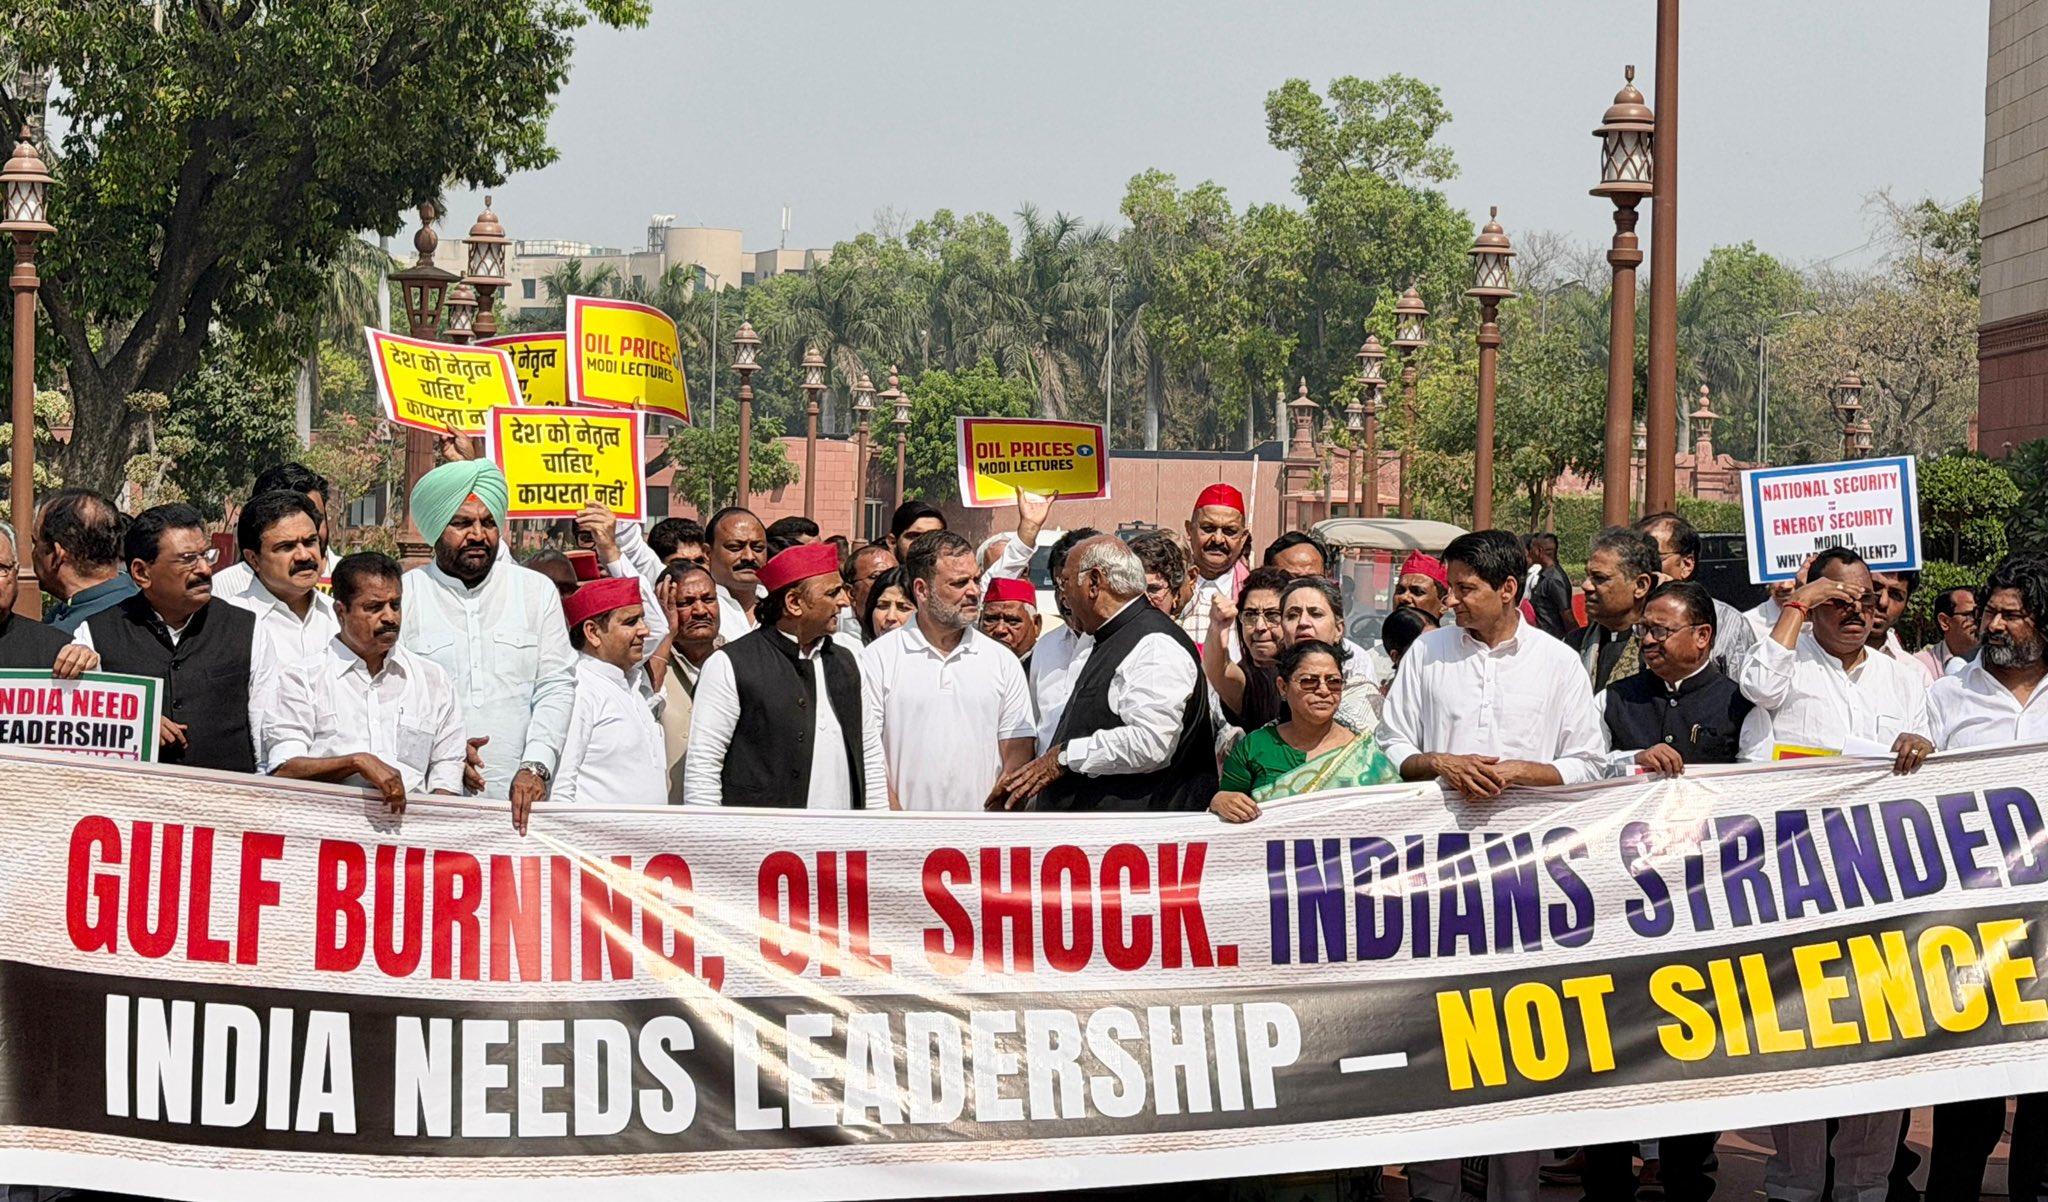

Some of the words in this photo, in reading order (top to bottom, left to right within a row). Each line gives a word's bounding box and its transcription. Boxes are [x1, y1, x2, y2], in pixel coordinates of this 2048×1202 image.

[518, 344, 557, 378] नेतृत्व
[585, 333, 613, 355] OIL
[620, 336, 672, 365] PRICES
[390, 343, 416, 369] देश
[416, 350, 442, 374] को
[443, 352, 492, 385] नेतृत्व
[587, 357, 617, 373] MODI
[621, 361, 673, 383] LECTURES
[418, 377, 472, 404] चाहिए,
[403, 398, 464, 425] कायरता
[510, 417, 542, 443] देश
[546, 417, 571, 443] को
[574, 418, 621, 454] नेतृत्व
[976, 442, 1005, 459] OIL
[1011, 441, 1075, 458] PRICES
[541, 448, 600, 477] चाहिए,
[978, 461, 1011, 475] MODI
[1014, 459, 1074, 473] LECTURES
[516, 483, 589, 504] कायरता
[592, 480, 627, 506] नहीं
[1763, 480, 1829, 501] NATIONAL
[1834, 472, 1897, 495] SECURITY
[1773, 515, 1825, 536] ENERGY
[1829, 508, 1893, 530] SECURITY
[1814, 534, 1842, 550] MODI
[1776, 553, 1803, 568] WHY
[0, 688, 64, 715] NDIA
[71, 689, 139, 720] NEED
[0, 719, 138, 752] EADERSHIP,
[65, 815, 286, 966] GULF
[314, 838, 724, 992] BURNING,
[757, 850, 892, 977] OIL
[922, 841, 1239, 976] SHOCK.
[1265, 826, 1595, 965] INDIANS
[1619, 787, 2048, 938] STRANDED
[105, 993, 357, 1136] INDIA
[394, 1015, 696, 1139] NEEDS
[733, 1001, 1301, 1132] LEADERSHIP
[1437, 974, 1616, 1092] NOT
[1649, 918, 2048, 1061] SILENCE
